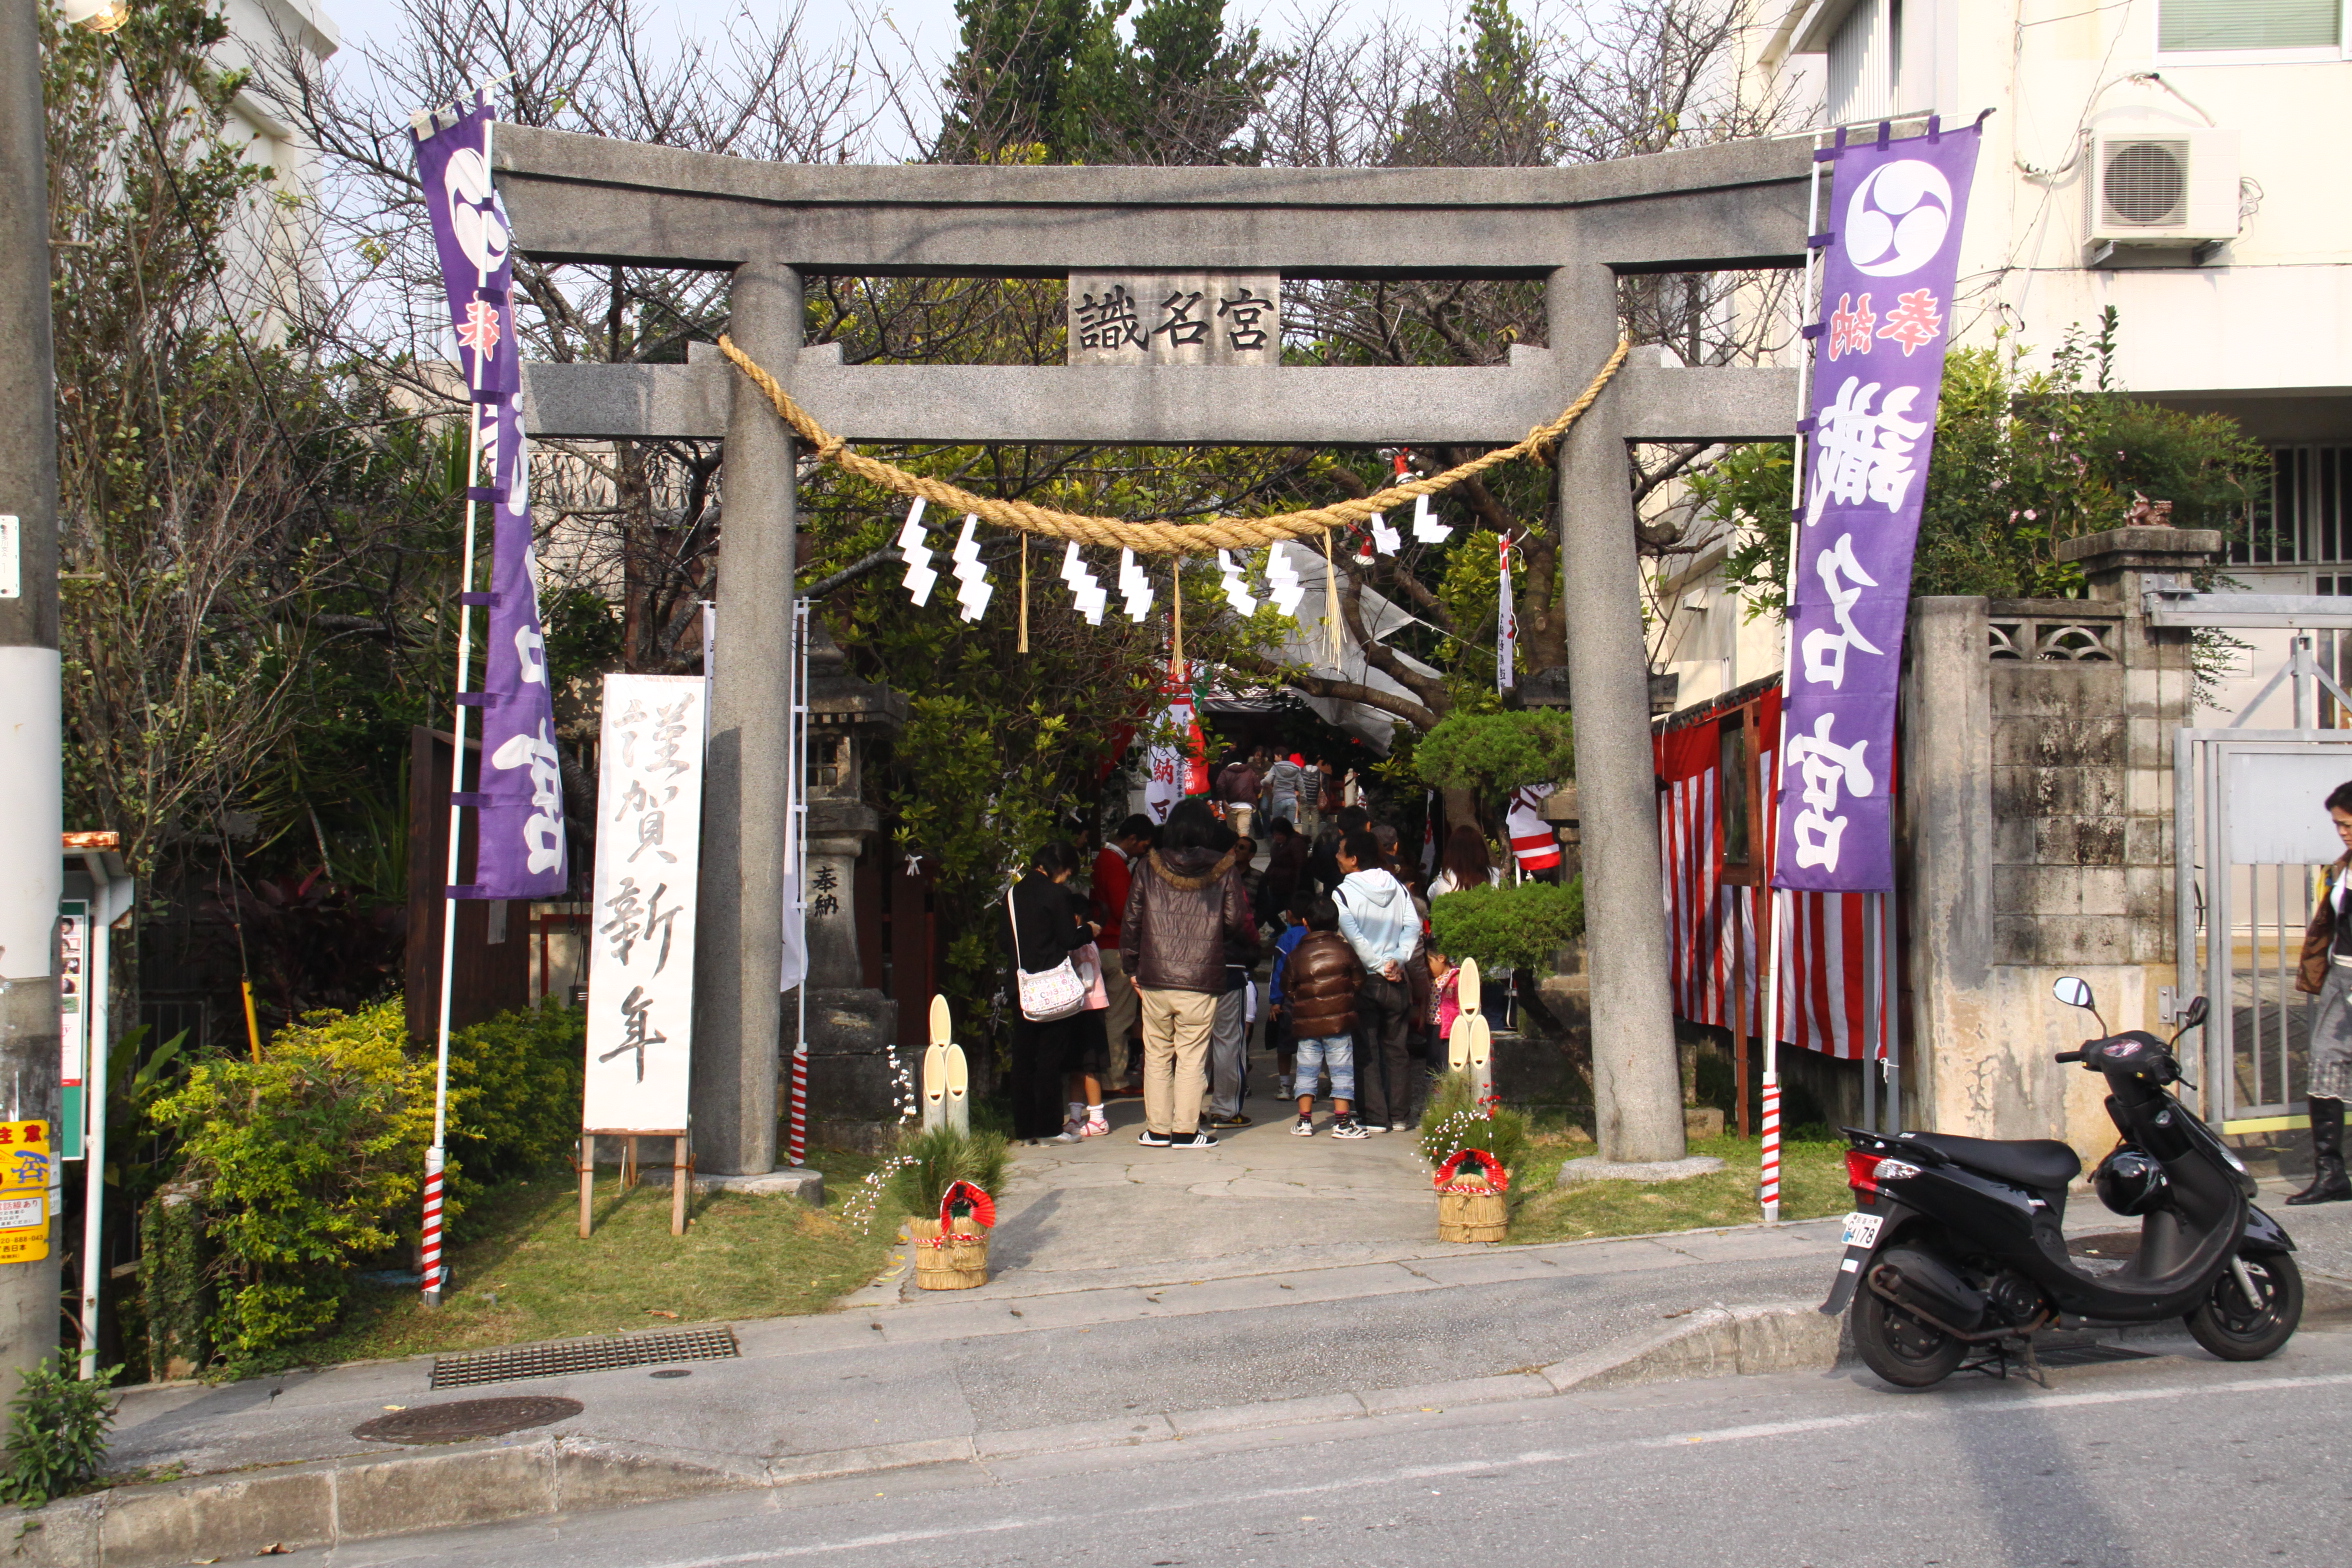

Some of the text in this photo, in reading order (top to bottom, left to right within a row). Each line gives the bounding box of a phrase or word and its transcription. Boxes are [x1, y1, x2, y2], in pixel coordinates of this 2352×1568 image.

[1075, 284, 1275, 352] 識名宮
[598, 691, 695, 1086] 謹賀新年
[812, 866, 839, 919] 奉納
[0, 1200, 38, 1210] 話線あり
[0, 1244, 27, 1253] 西日本
